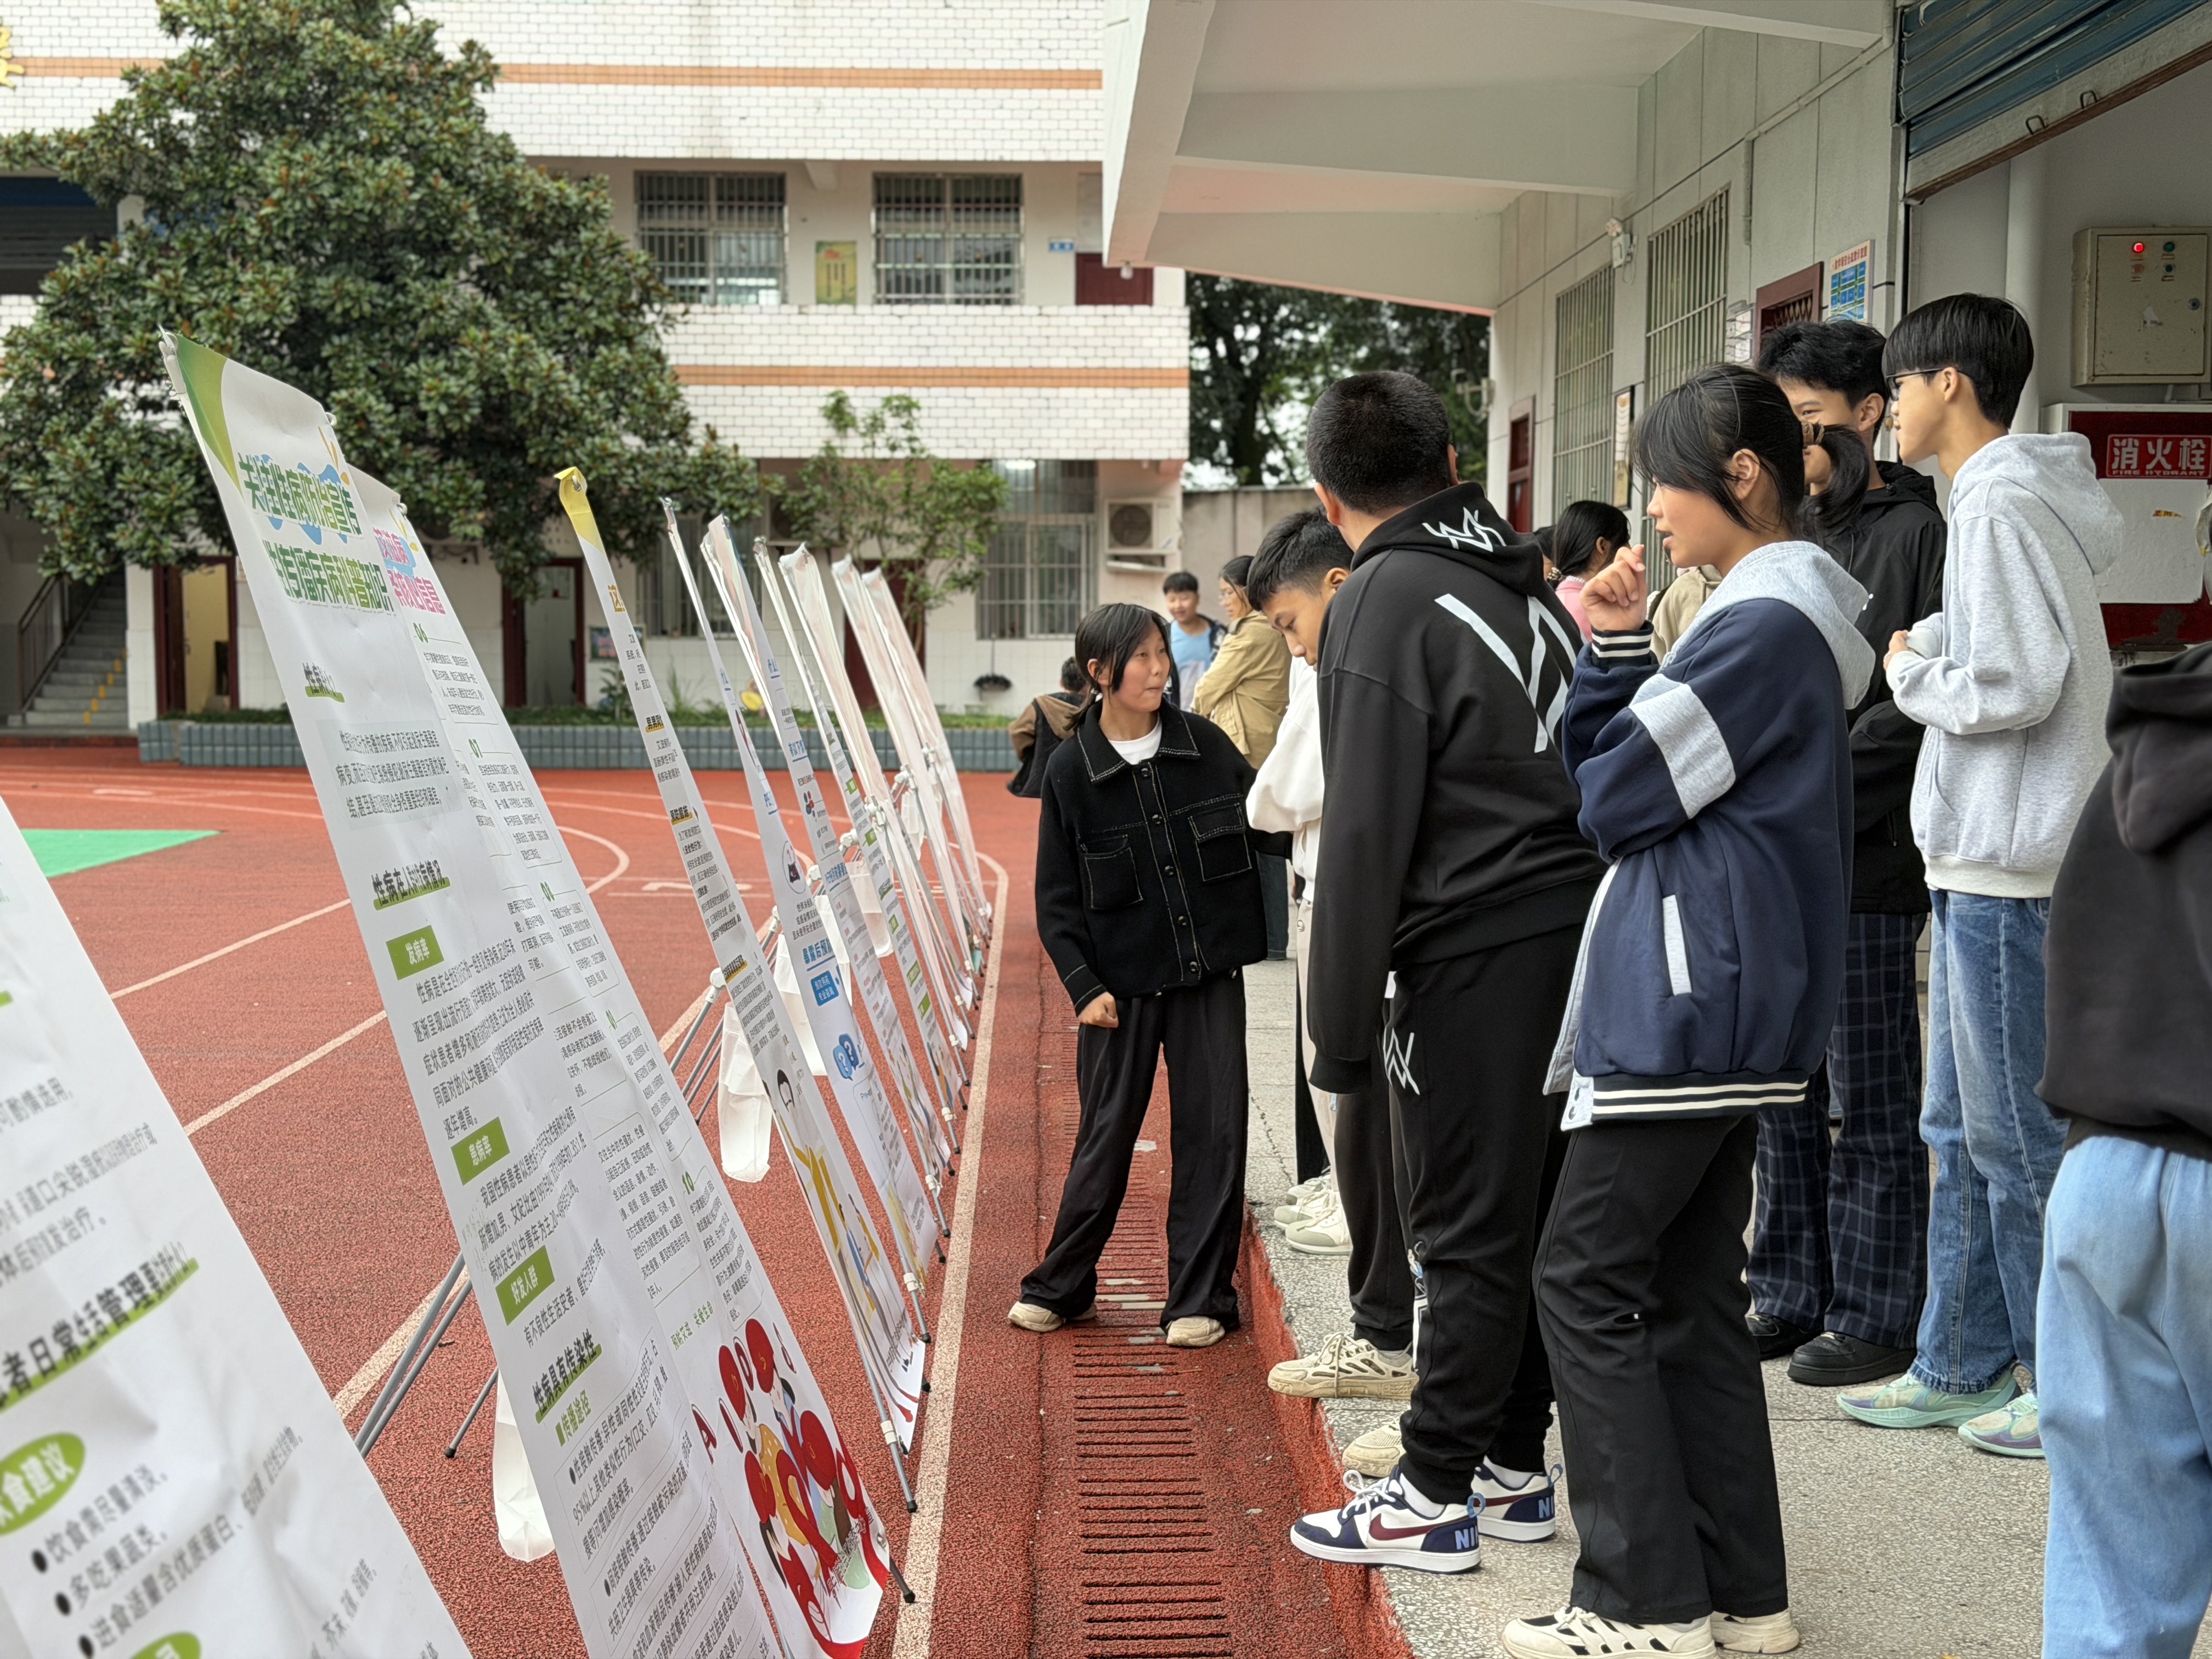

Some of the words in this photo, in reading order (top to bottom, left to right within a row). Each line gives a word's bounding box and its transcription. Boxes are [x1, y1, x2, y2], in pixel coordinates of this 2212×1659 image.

[2112, 438, 2206, 470] 消火栓
[238, 452, 362, 535] 关注性病防治宣传
[262, 540, 394, 611] 性传播疾病科普知识
[405, 937, 430, 966] 发病率
[442, 1105, 478, 1141] 逐年增高。
[469, 1135, 493, 1166] 患病率
[681, 1171, 695, 1195] 10
[510, 1264, 539, 1306] 好发人群
[532, 1328, 597, 1418] 性病具有传染性
[561, 1389, 591, 1444] 传播途径
[44, 1463, 168, 1565] 饮食需尽量清淡。
[69, 1521, 168, 1610] 多吃果蔬类。
[608, 1555, 657, 1642] 共用卫生器具等传染。
